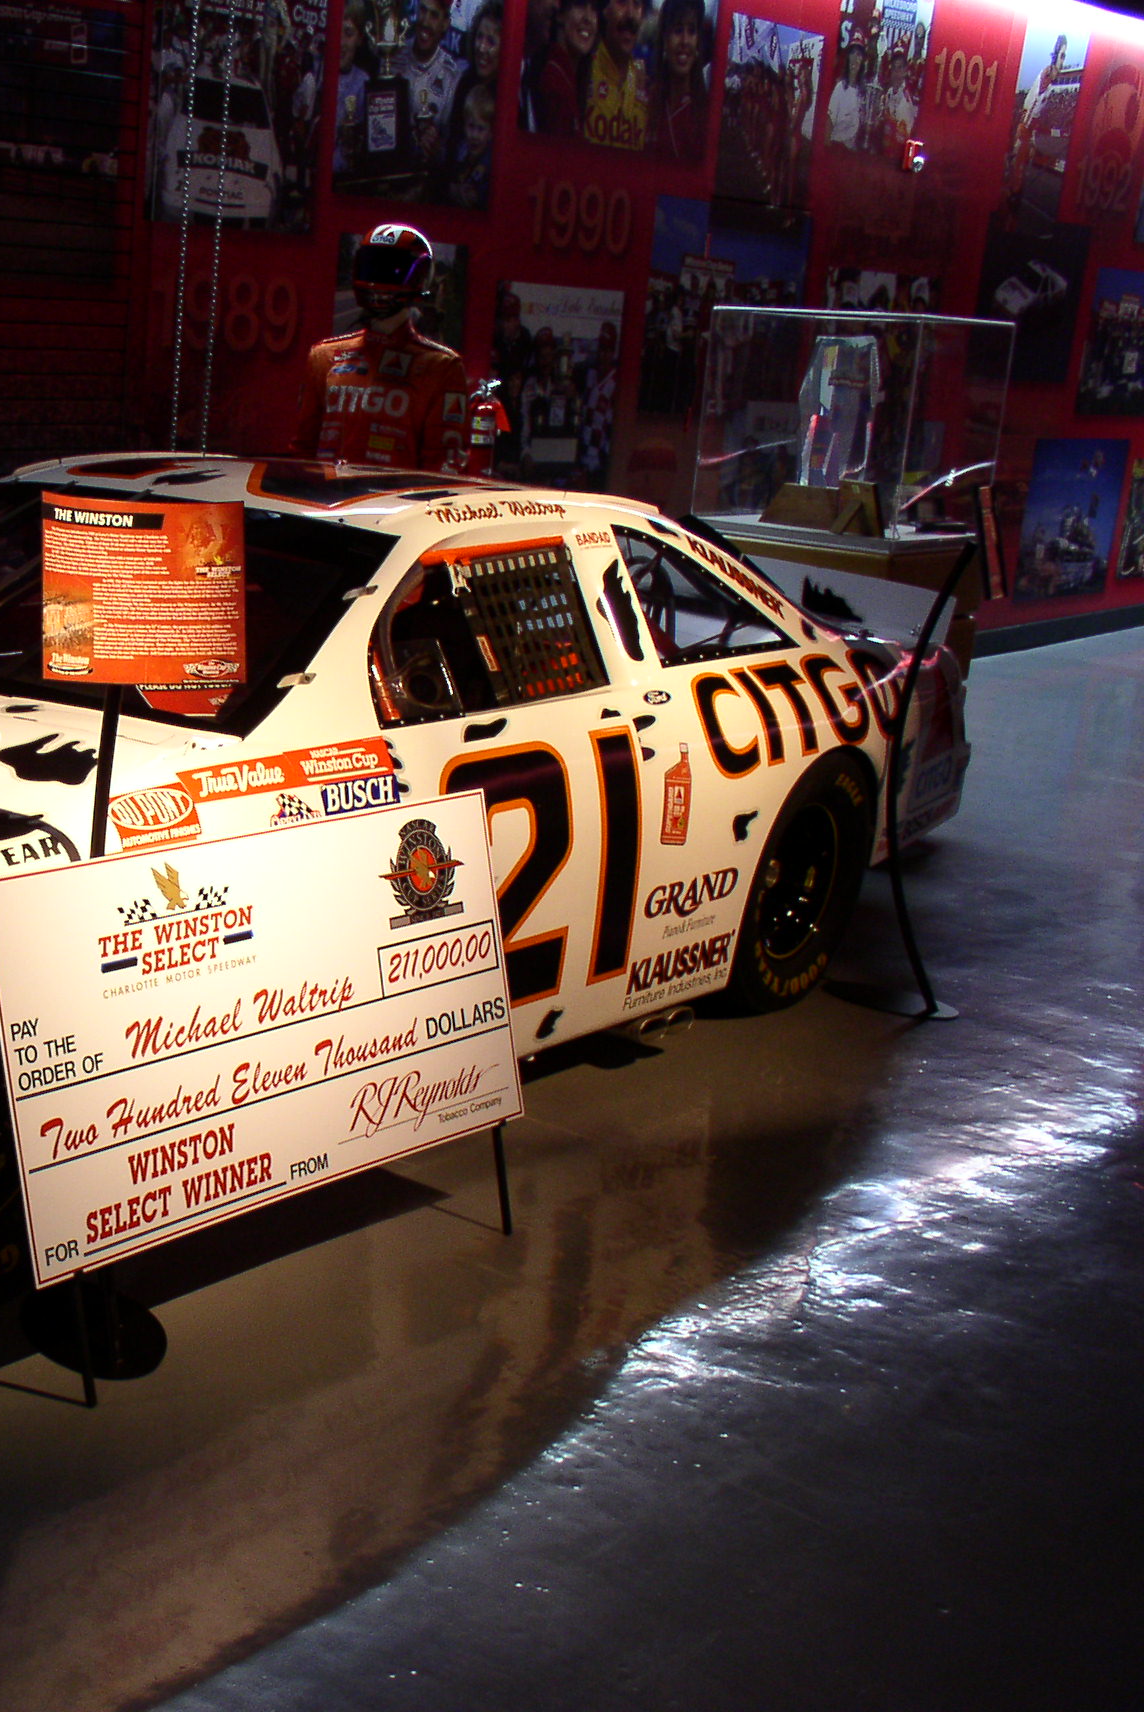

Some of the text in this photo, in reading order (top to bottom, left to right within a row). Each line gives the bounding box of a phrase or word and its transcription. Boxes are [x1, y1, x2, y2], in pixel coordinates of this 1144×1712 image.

[934, 47, 999, 116] 1991
[1075, 151, 1133, 212] 1992
[527, 179, 632, 256] 1990
[155, 268, 299, 354] 1989
[326, 385, 410, 418] CITGO
[54, 507, 134, 528] THE WINSTON
[690, 649, 904, 780] CITGO
[300, 753, 379, 776] Winston Cup
[325, 776, 394, 813] BUSCH
[439, 725, 643, 1009] 21
[644, 867, 739, 919] GRAND
[98, 905, 254, 958] THE WINSTON
[142, 936, 220, 976] SELECT
[102, 954, 257, 1000] CHARLOTTE MOTOR SPEEDWAY
[626, 930, 733, 996] KLAUSSNER
[125, 975, 355, 1060] Michael Waltrip
[622, 987, 666, 1011] Furniture
[10, 1018, 39, 1042] PAY
[13, 1034, 77, 1066] TO THE
[17, 1052, 104, 1092] ORDER OF
[40, 996, 505, 1161] Two Hundred Eleven Thousand DOLLARS
[437, 1096, 503, 1125] Tobacco Company
[128, 1123, 235, 1185] WINSTON
[289, 1153, 330, 1181] FROM
[86, 1152, 273, 1245] SELECT WINNER
[44, 1239, 80, 1267] FOR
